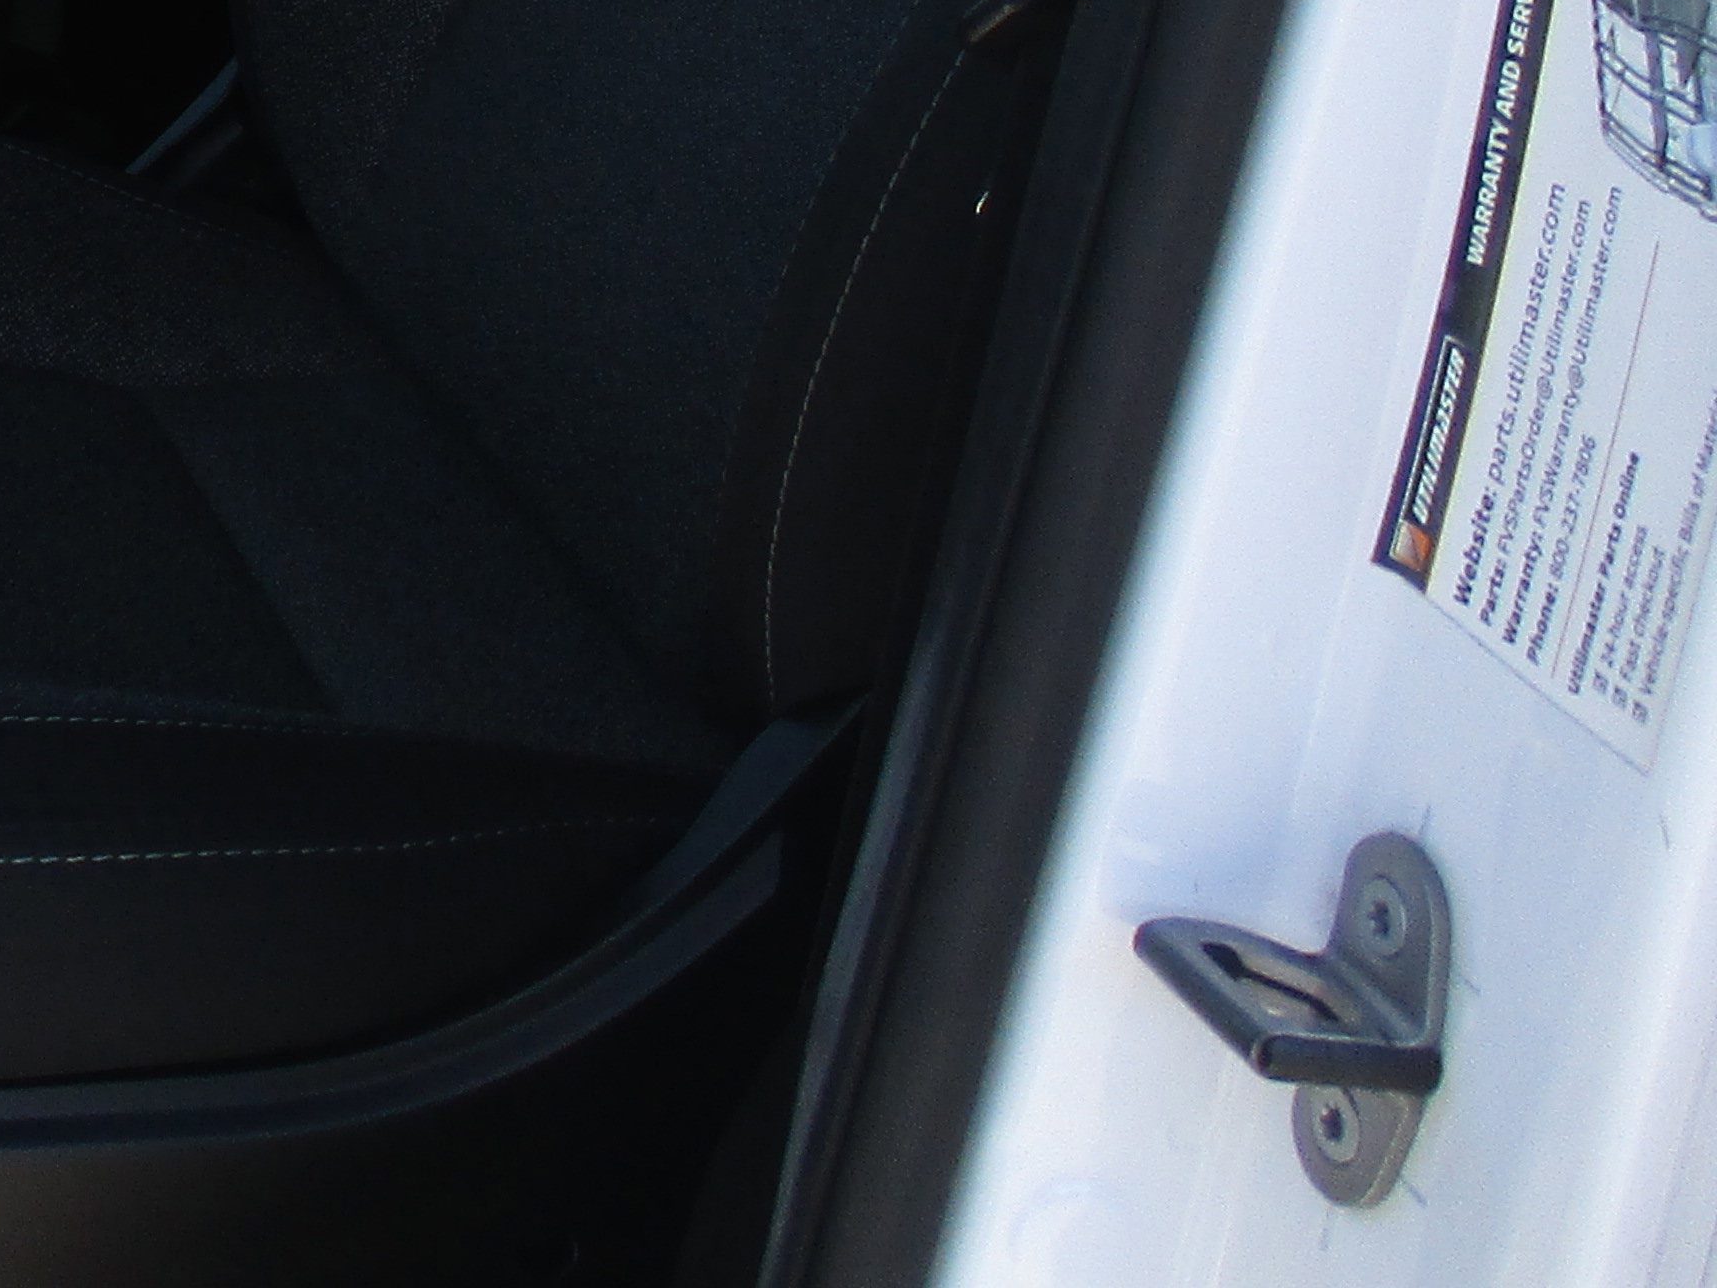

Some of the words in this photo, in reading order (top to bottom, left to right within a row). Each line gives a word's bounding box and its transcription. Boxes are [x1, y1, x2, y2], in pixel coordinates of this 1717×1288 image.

[1464, 114, 1511, 267] WARRANTY
[1494, 53, 1523, 123] AND
[1452, 481, 1498, 609] Website:
[1485, 177, 1566, 487] parts.utilimaster.com
[1477, 554, 1507, 628] Parts:
[1501, 528, 1544, 646] Warranty:
[1525, 579, 1559, 666] Phone:
[1566, 579, 1607, 697] Utilimaster
[1596, 519, 1622, 580] Parts
[1610, 449, 1641, 521] Online
[1617, 637, 1642, 684] Fast
